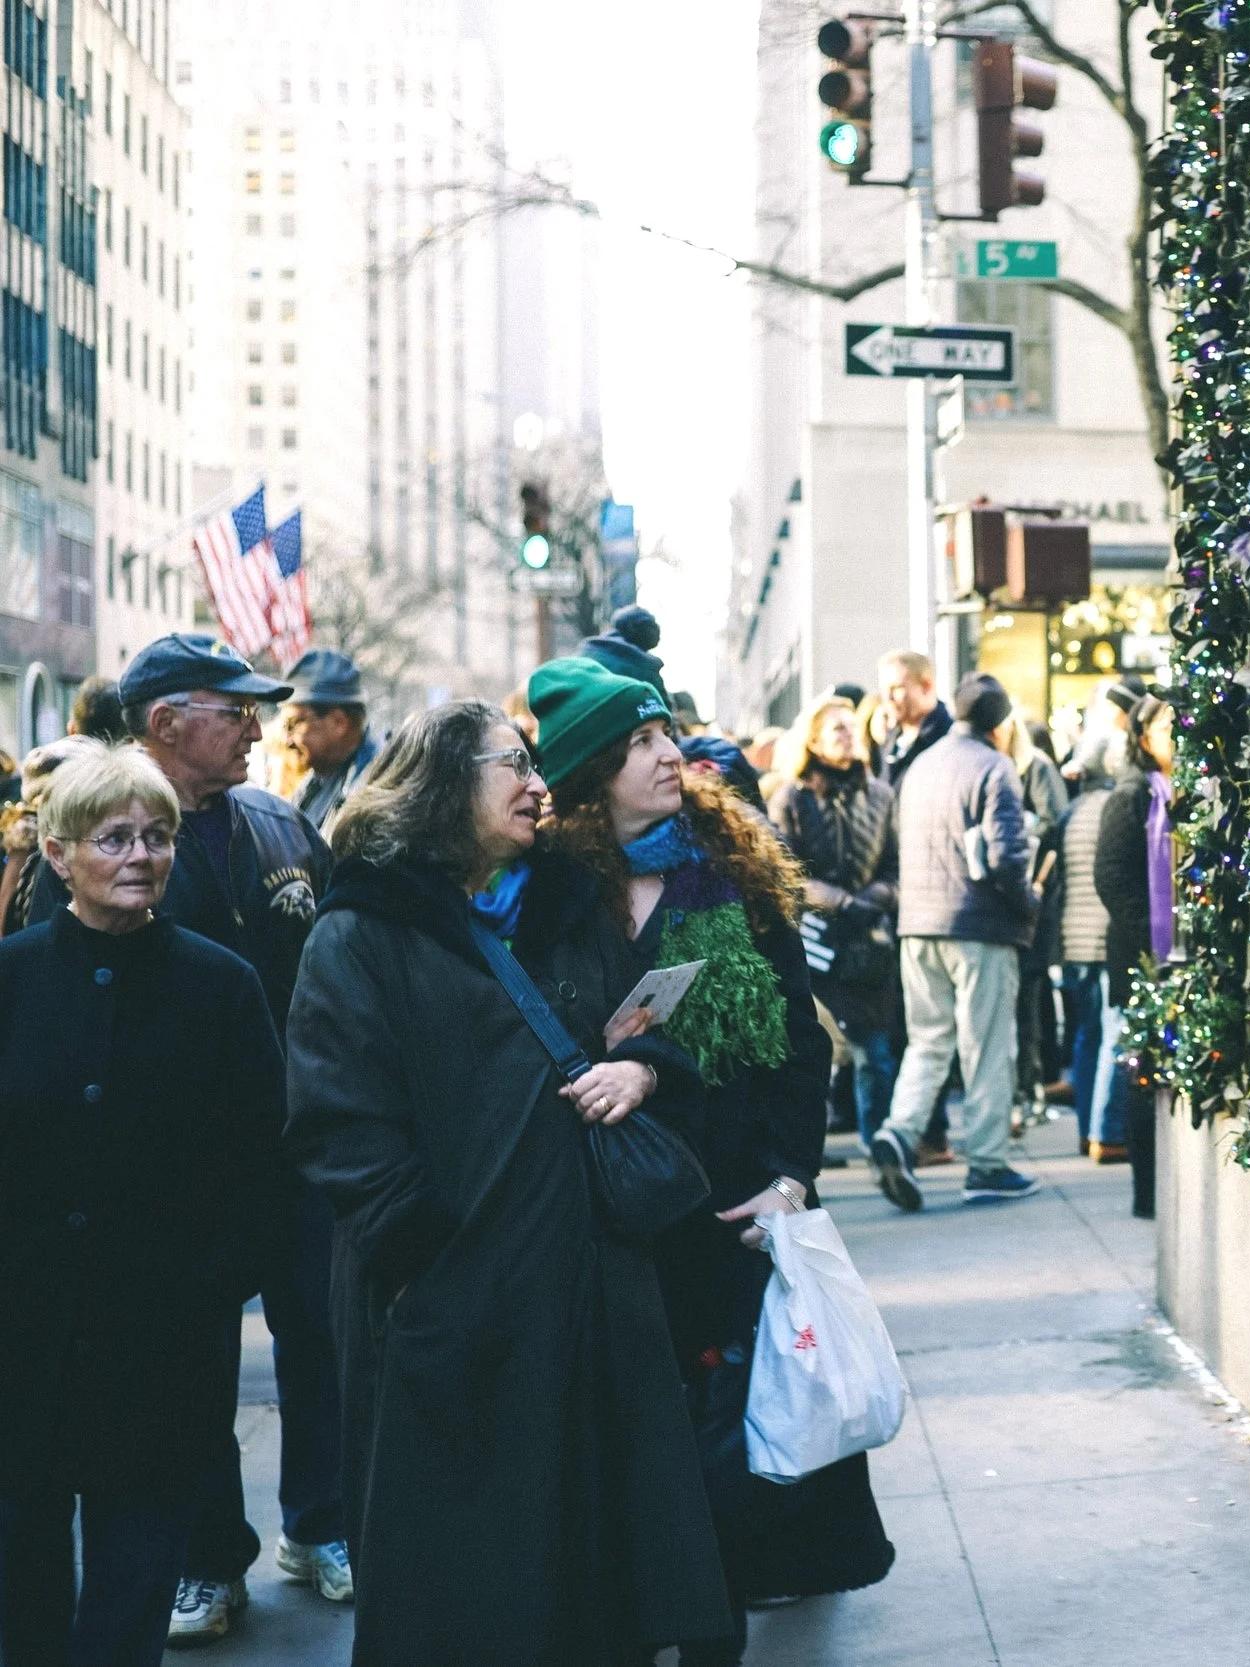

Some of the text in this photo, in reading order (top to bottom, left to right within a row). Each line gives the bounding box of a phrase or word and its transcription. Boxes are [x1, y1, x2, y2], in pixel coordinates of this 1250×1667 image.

[985, 243, 1009, 275] 5
[869, 339, 993, 363] ONE WAY
